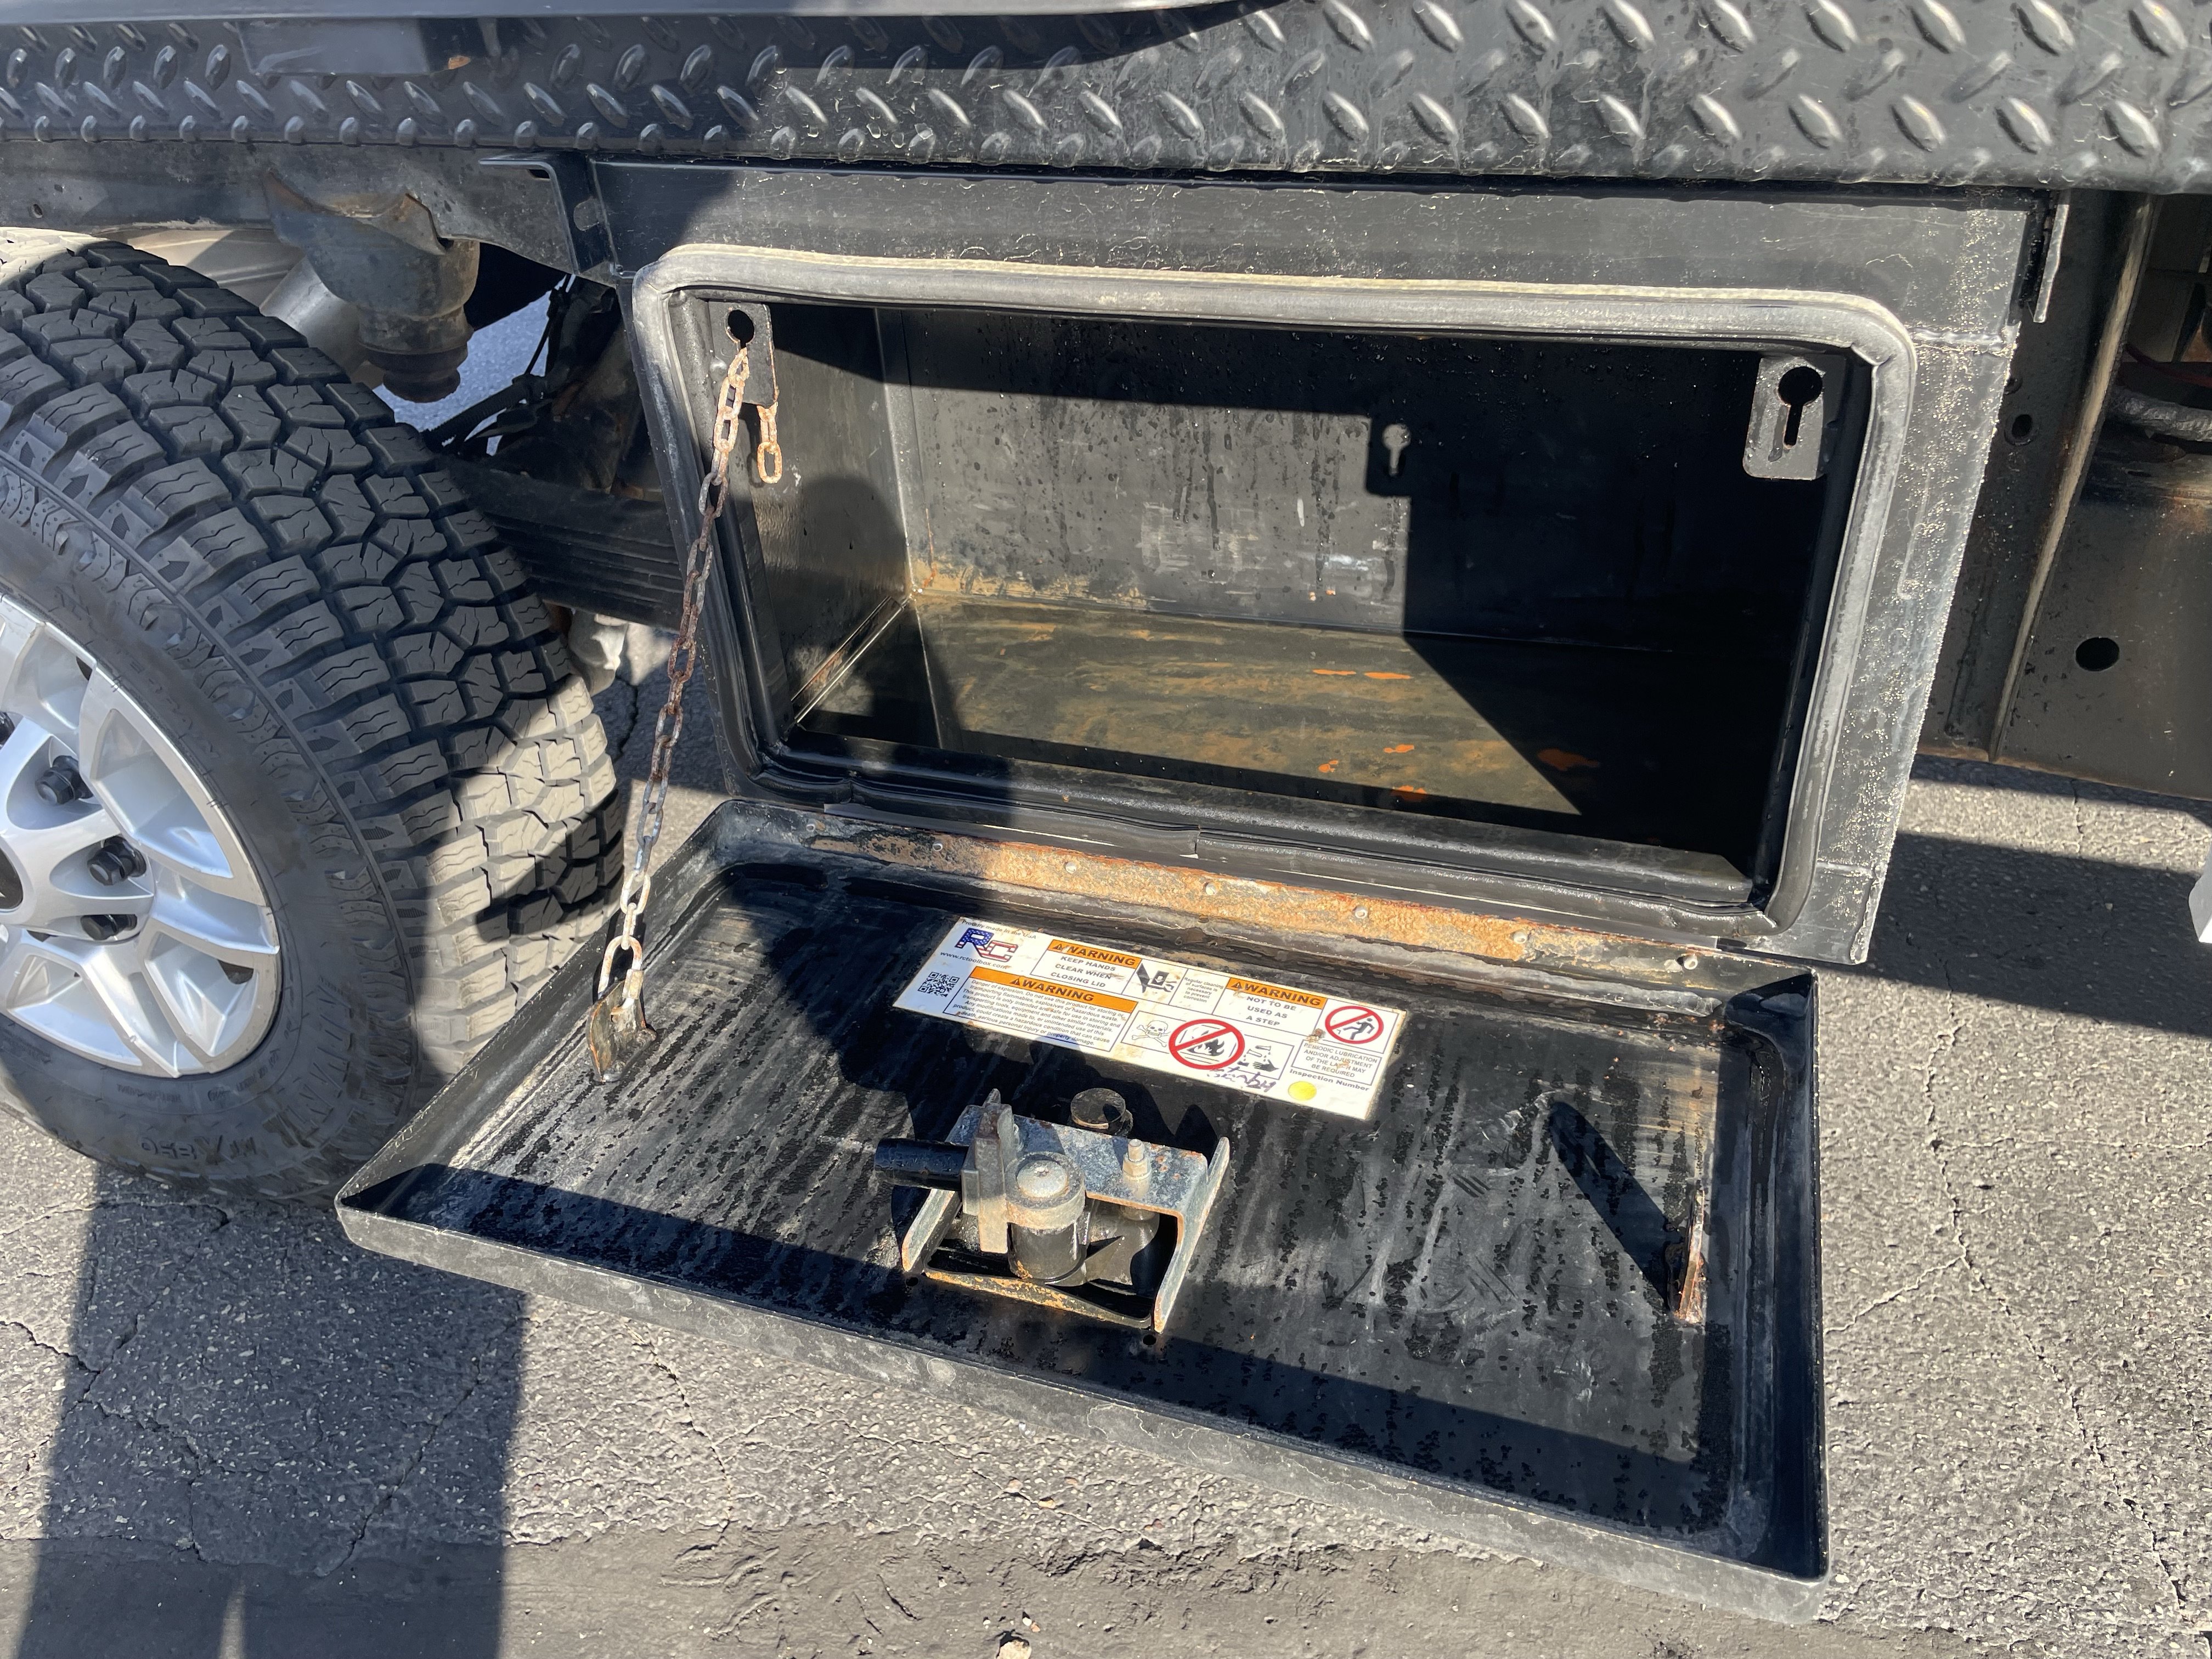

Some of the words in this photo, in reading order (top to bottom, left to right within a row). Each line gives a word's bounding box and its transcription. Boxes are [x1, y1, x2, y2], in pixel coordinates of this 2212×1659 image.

[955, 927, 1019, 962] RC
[940, 952, 1008, 969] www.rctoolbox.com
[1060, 956, 1084, 964] KEEP
[1085, 961, 1116, 972] HANDS
[1050, 972, 1090, 984] CLOSING
[1054, 964, 1084, 973] CLEAR
[1085, 970, 1112, 980] WHEN
[970, 985, 1002, 996] transporting
[1003, 991, 1034, 1003] flammables,
[1035, 1000, 1064, 1009] explosives
[1072, 1007, 1100, 1018] hazardous
[997, 986, 1024, 995] explosion.
[1066, 1001, 1088, 1009] product
[1097, 1008, 1117, 1017] storing
[1022, 979, 1094, 1002] WARNING
[1244, 983, 1322, 1006] WARNING
[953, 1003, 975, 1013] product,
[1014, 1017, 1043, 1028] hazardous
[1043, 1024, 1070, 1034] condition
[962, 994, 995, 1005] transporting
[1012, 1006, 1040, 1016] equipment
[1067, 1017, 1086, 1025] similar
[1086, 1022, 1113, 1032] materials.
[974, 992, 996, 1001] product
[1015, 1001, 1039, 1009] intended
[1088, 1017, 1109, 1027] storing
[976, 1003, 1012, 1014] modifications
[1044, 1018, 1075, 1029] unintended
[1247, 1005, 1273, 1015] USED
[998, 1019, 1023, 1029] personal
[1024, 1025, 1040, 1033] injury
[1047, 1031, 1070, 1041] property
[1071, 1037, 1095, 1046] damage.
[1255, 1017, 1280, 1026] STEP
[1304, 1042, 1334, 1053] PERIODIC
[1335, 1049, 1378, 1063] LUBRICATION
[1304, 1049, 1329, 1059] AND/OR
[1329, 1055, 1373, 1069] ADJUSTMENT
[1289, 1069, 1334, 1083] Inspection
[1336, 1080, 1369, 1091] Number
[1321, 1066, 1355, 1077] REQUIRED
